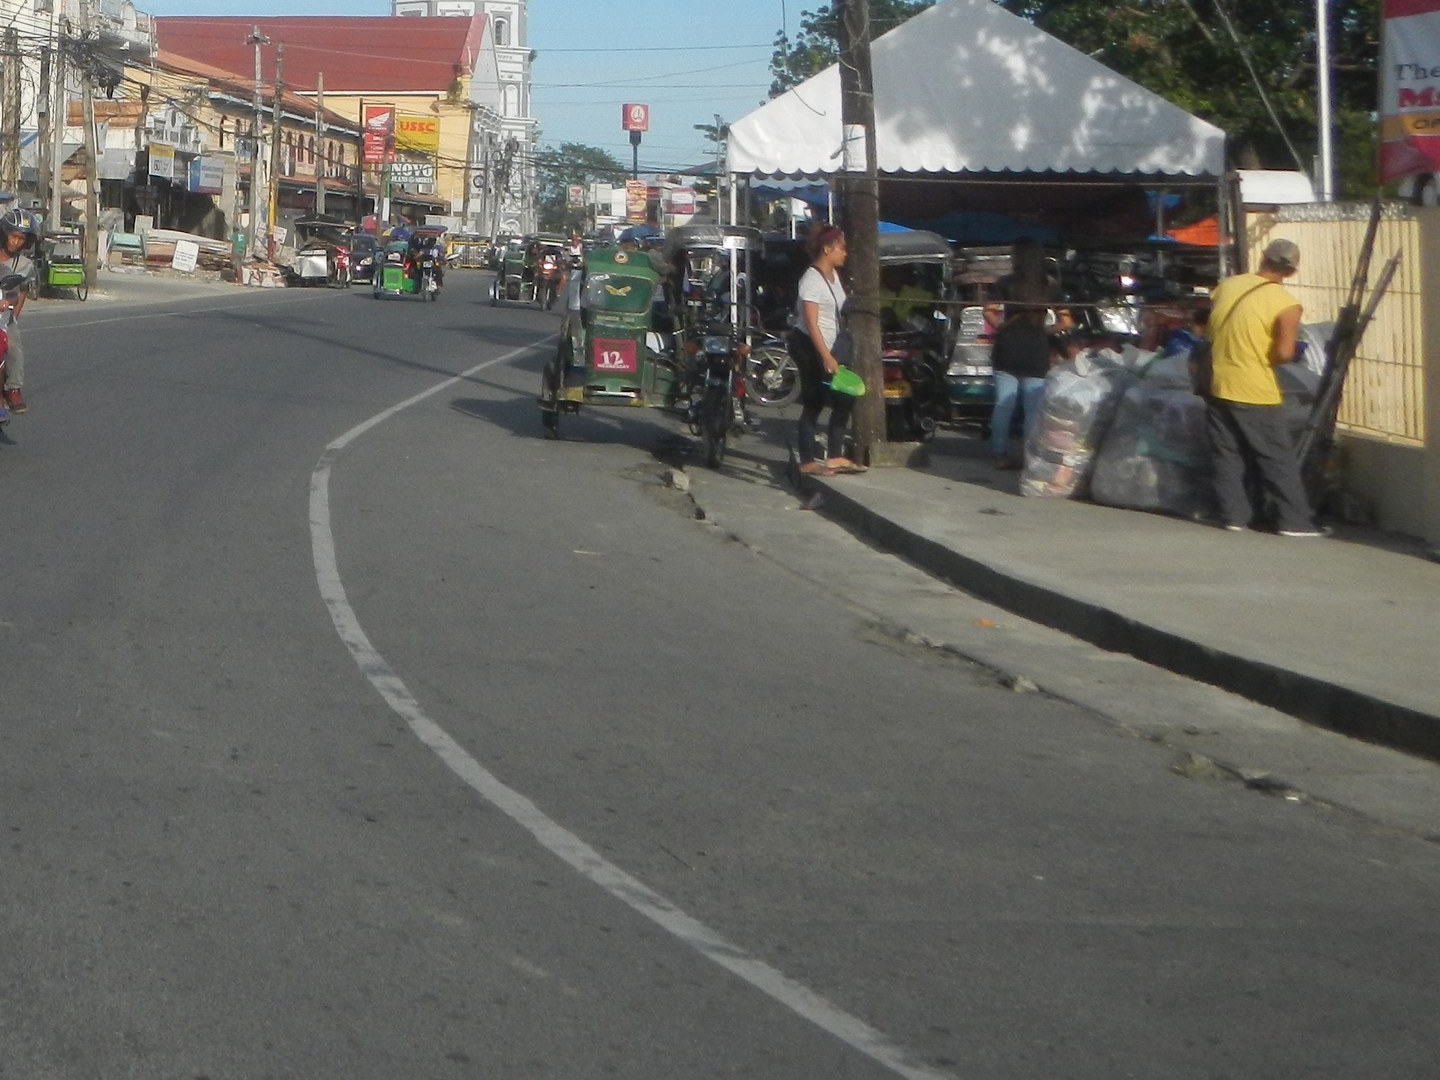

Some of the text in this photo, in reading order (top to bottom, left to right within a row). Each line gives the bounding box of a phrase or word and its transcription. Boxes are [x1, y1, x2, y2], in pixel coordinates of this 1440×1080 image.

[399, 121, 436, 132] USSC
[391, 163, 433, 177] NOVO
[600, 350, 624, 365] 12
